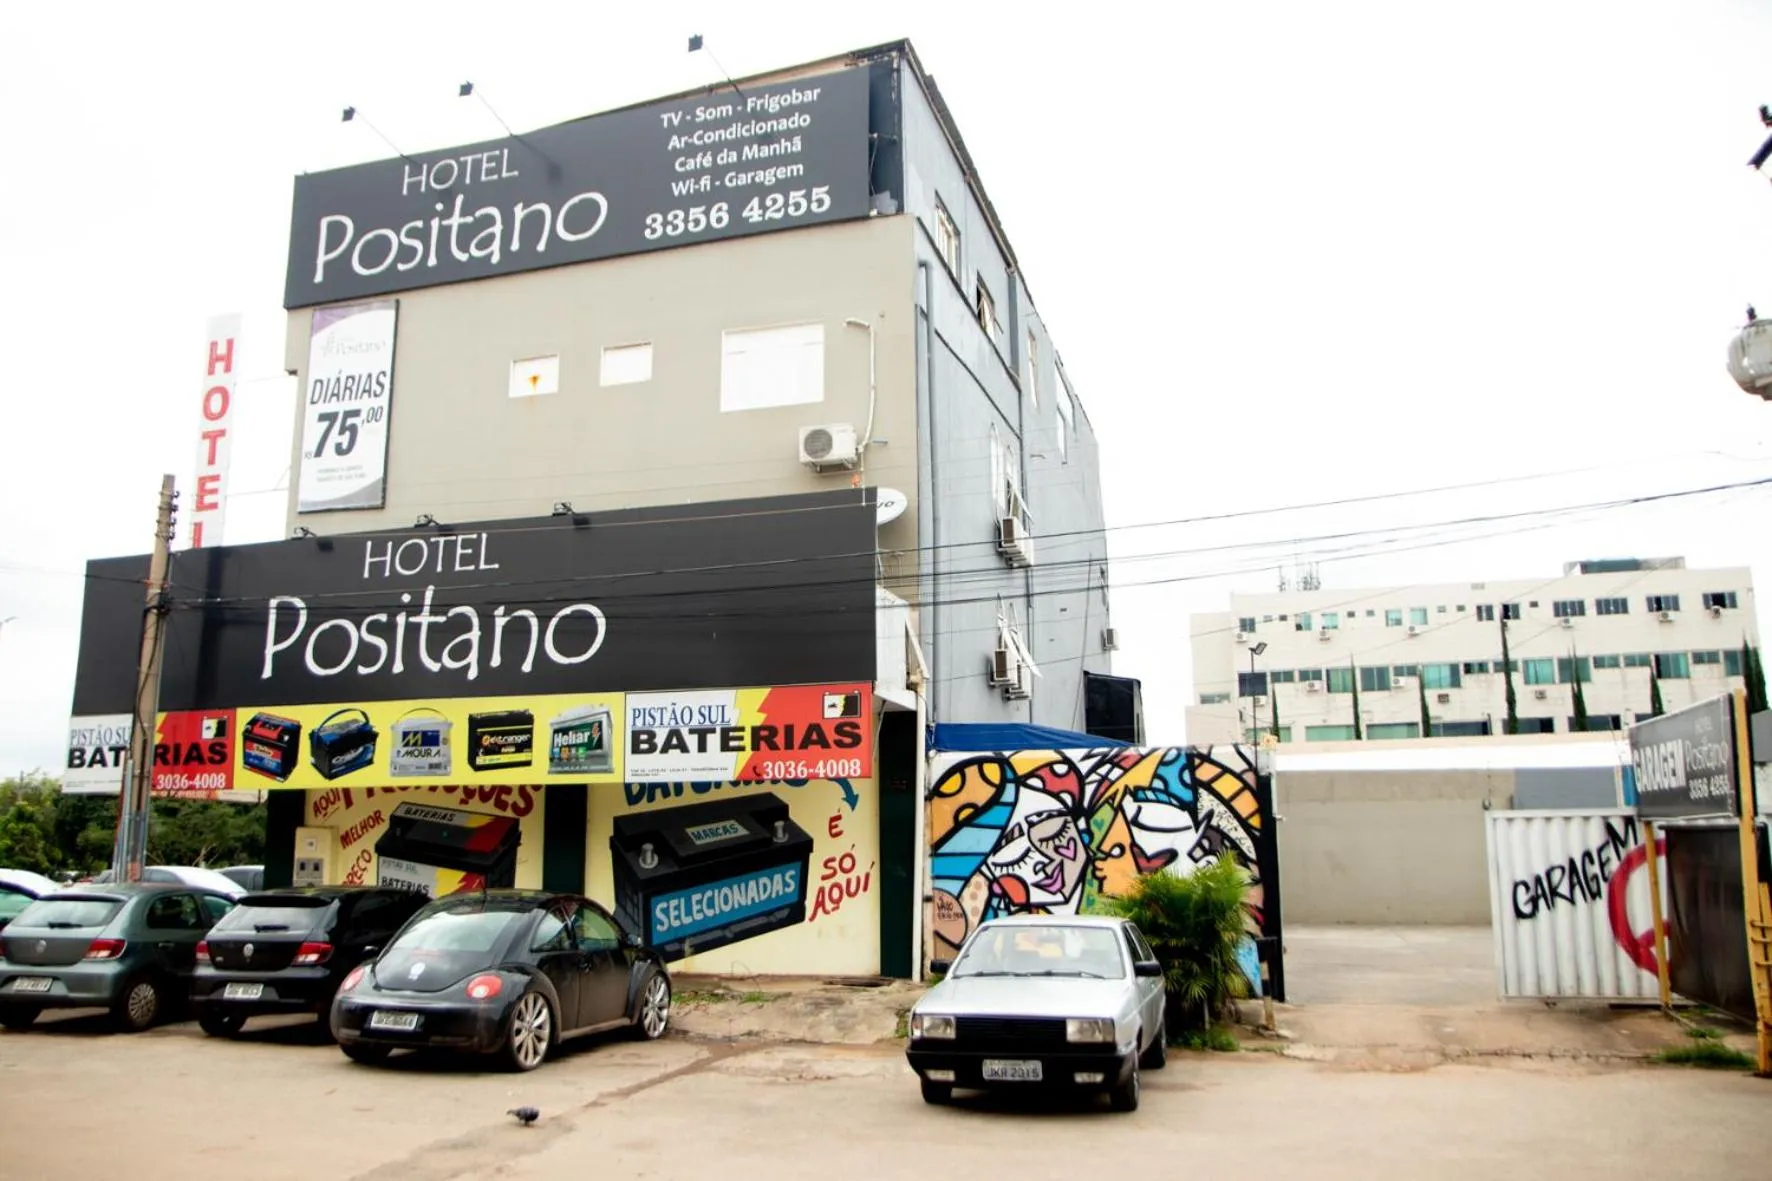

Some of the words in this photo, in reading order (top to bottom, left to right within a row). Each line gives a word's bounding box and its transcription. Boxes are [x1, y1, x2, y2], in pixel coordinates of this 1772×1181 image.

[660, 111, 682, 128] TV
[695, 104, 732, 123] Som
[747, 88, 821, 112] Frigobar
[667, 113, 811, 151] Ar-Condicionado
[402, 149, 518, 195] HOTEL
[674, 151, 712, 173] Café
[717, 148, 738, 165] da
[742, 135, 802, 161] Manhã
[671, 175, 711, 197] Wi-fi
[725, 163, 803, 186] Garagem
[644, 202, 730, 240] 3356
[742, 185, 831, 223] 4255
[313, 192, 607, 282] Positano
[310, 369, 387, 405] DIÁRIAS
[363, 532, 500, 579] HOTEL
[260, 585, 607, 681] Positano
[631, 702, 693, 727] PISTÃO
[698, 704, 731, 725] SUL
[70, 724, 113, 746] PISTÃO
[116, 726, 132, 745] SU
[554, 731, 590, 747] Heliar
[631, 721, 862, 755] BATERIAS
[763, 758, 861, 780] 3036-4008
[1633, 738, 1686, 793] GARAGEM
[1685, 736, 1728, 772] Positano
[157, 773, 226, 790] 3036-4008
[340, 809, 385, 850] MELHOR
[691, 823, 738, 842] MARCAS
[828, 807, 844, 839] É
[820, 844, 857, 881] SÓ
[1512, 815, 1638, 920] GARAGEM
[381, 876, 430, 895] BATERIAS
[655, 870, 796, 932] SELECIONADAS
